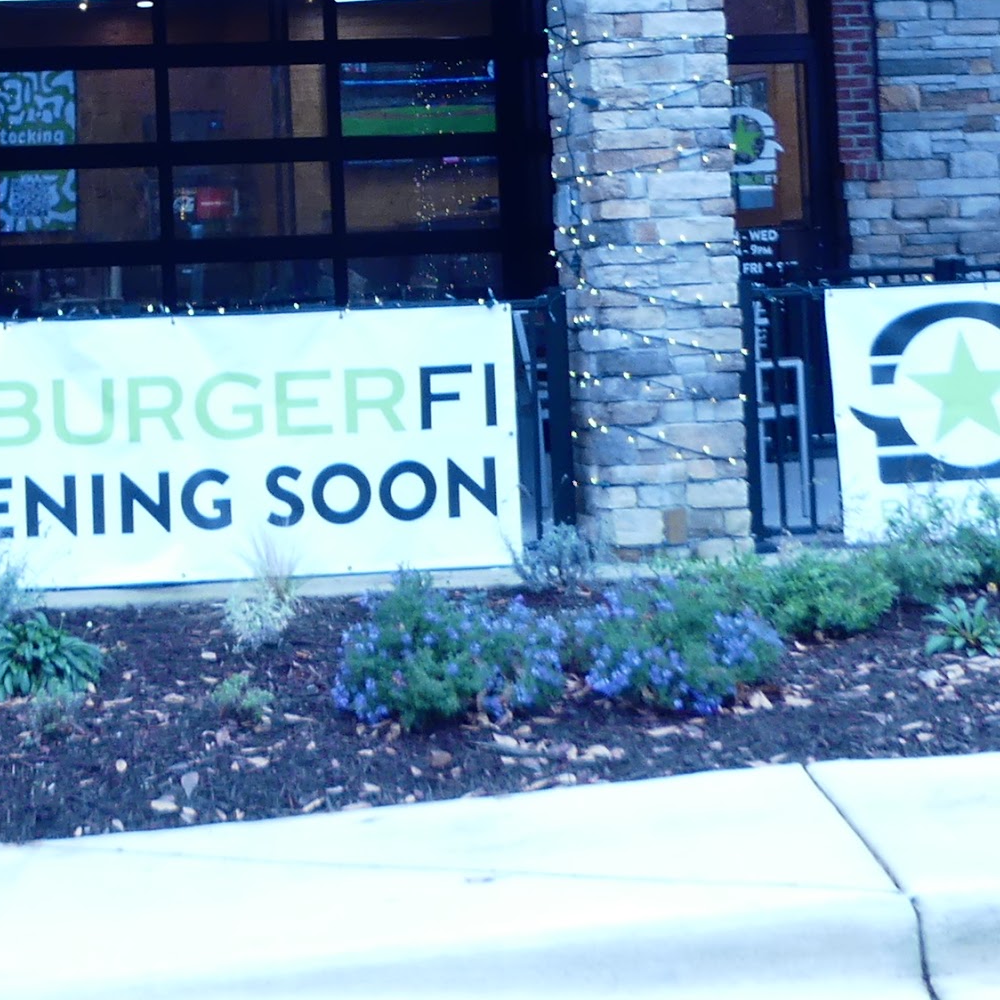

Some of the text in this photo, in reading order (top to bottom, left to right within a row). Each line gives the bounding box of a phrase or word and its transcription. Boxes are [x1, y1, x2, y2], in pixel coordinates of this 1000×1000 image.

[749, 229, 779, 242] WED
[742, 262, 764, 275] FRI
[266, 457, 498, 527] SOON
